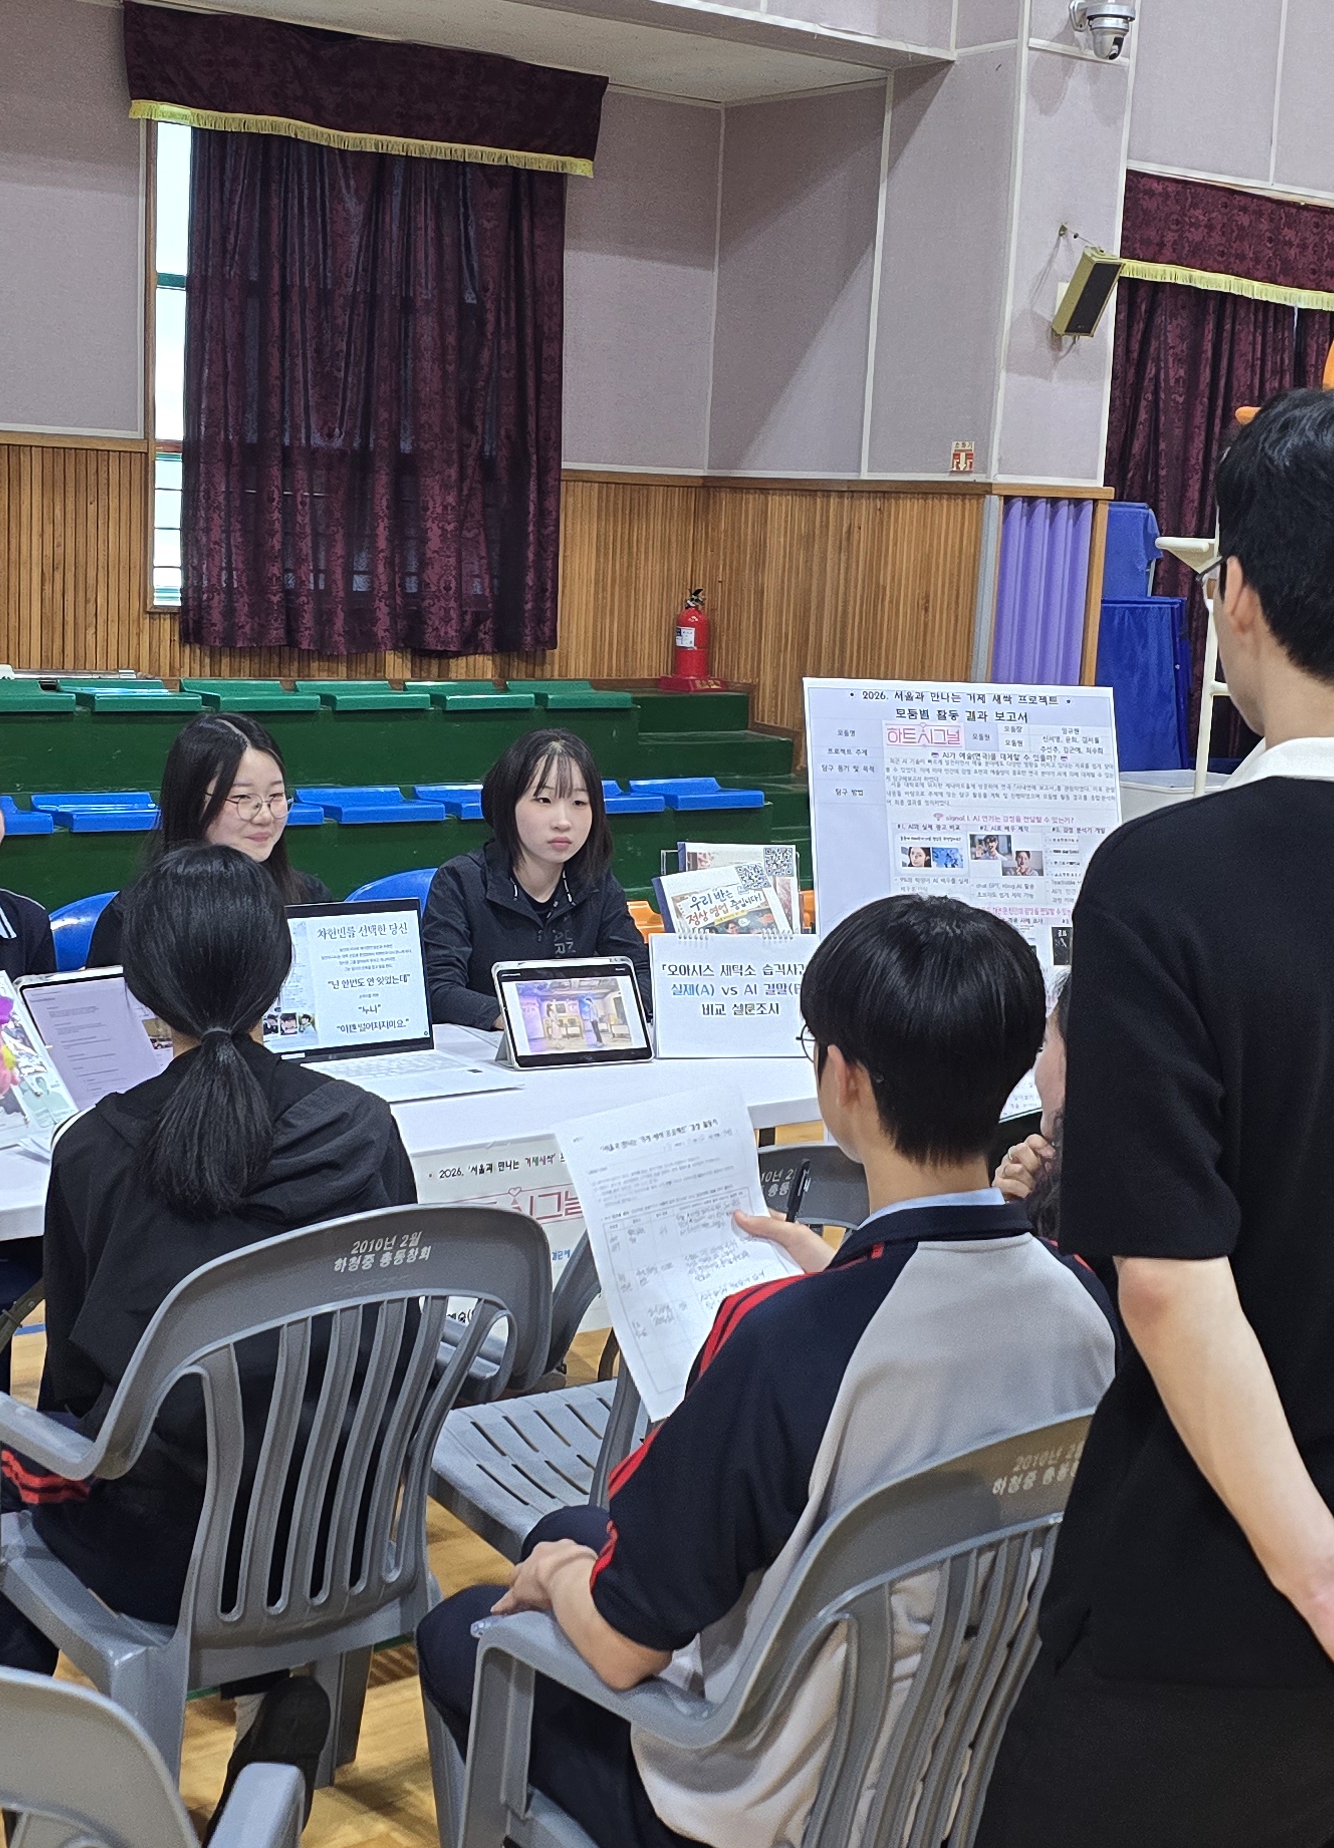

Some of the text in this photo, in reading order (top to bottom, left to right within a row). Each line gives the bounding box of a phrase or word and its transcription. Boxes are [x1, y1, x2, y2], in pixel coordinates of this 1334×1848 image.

[862, 690, 889, 701] 2026.
[893, 690, 924, 701] 서울과
[930, 691, 961, 702] 만나는
[1017, 694, 1059, 706] 프로젝트
[895, 707, 929, 720] 모둠별
[937, 708, 959, 720] 활동
[994, 710, 1027, 723] 보고서
[886, 727, 960, 745] 하트시그널
[690, 889, 734, 911] 우리 반은
[686, 911, 708, 926] 정상
[388, 922, 407, 935] 당신
[671, 984, 715, 996] 실제(A)
[721, 986, 738, 996] vs
[743, 984, 758, 995] AI
[702, 1003, 780, 1016] 비교 설문조사
[439, 1166, 464, 1179] 2026.
[497, 1159, 520, 1172] 만나는
[351, 1230, 422, 1255] 2010년 2월
[380, 1245, 432, 1268] 총동창회
[1042, 1460, 1080, 1486] 총동
